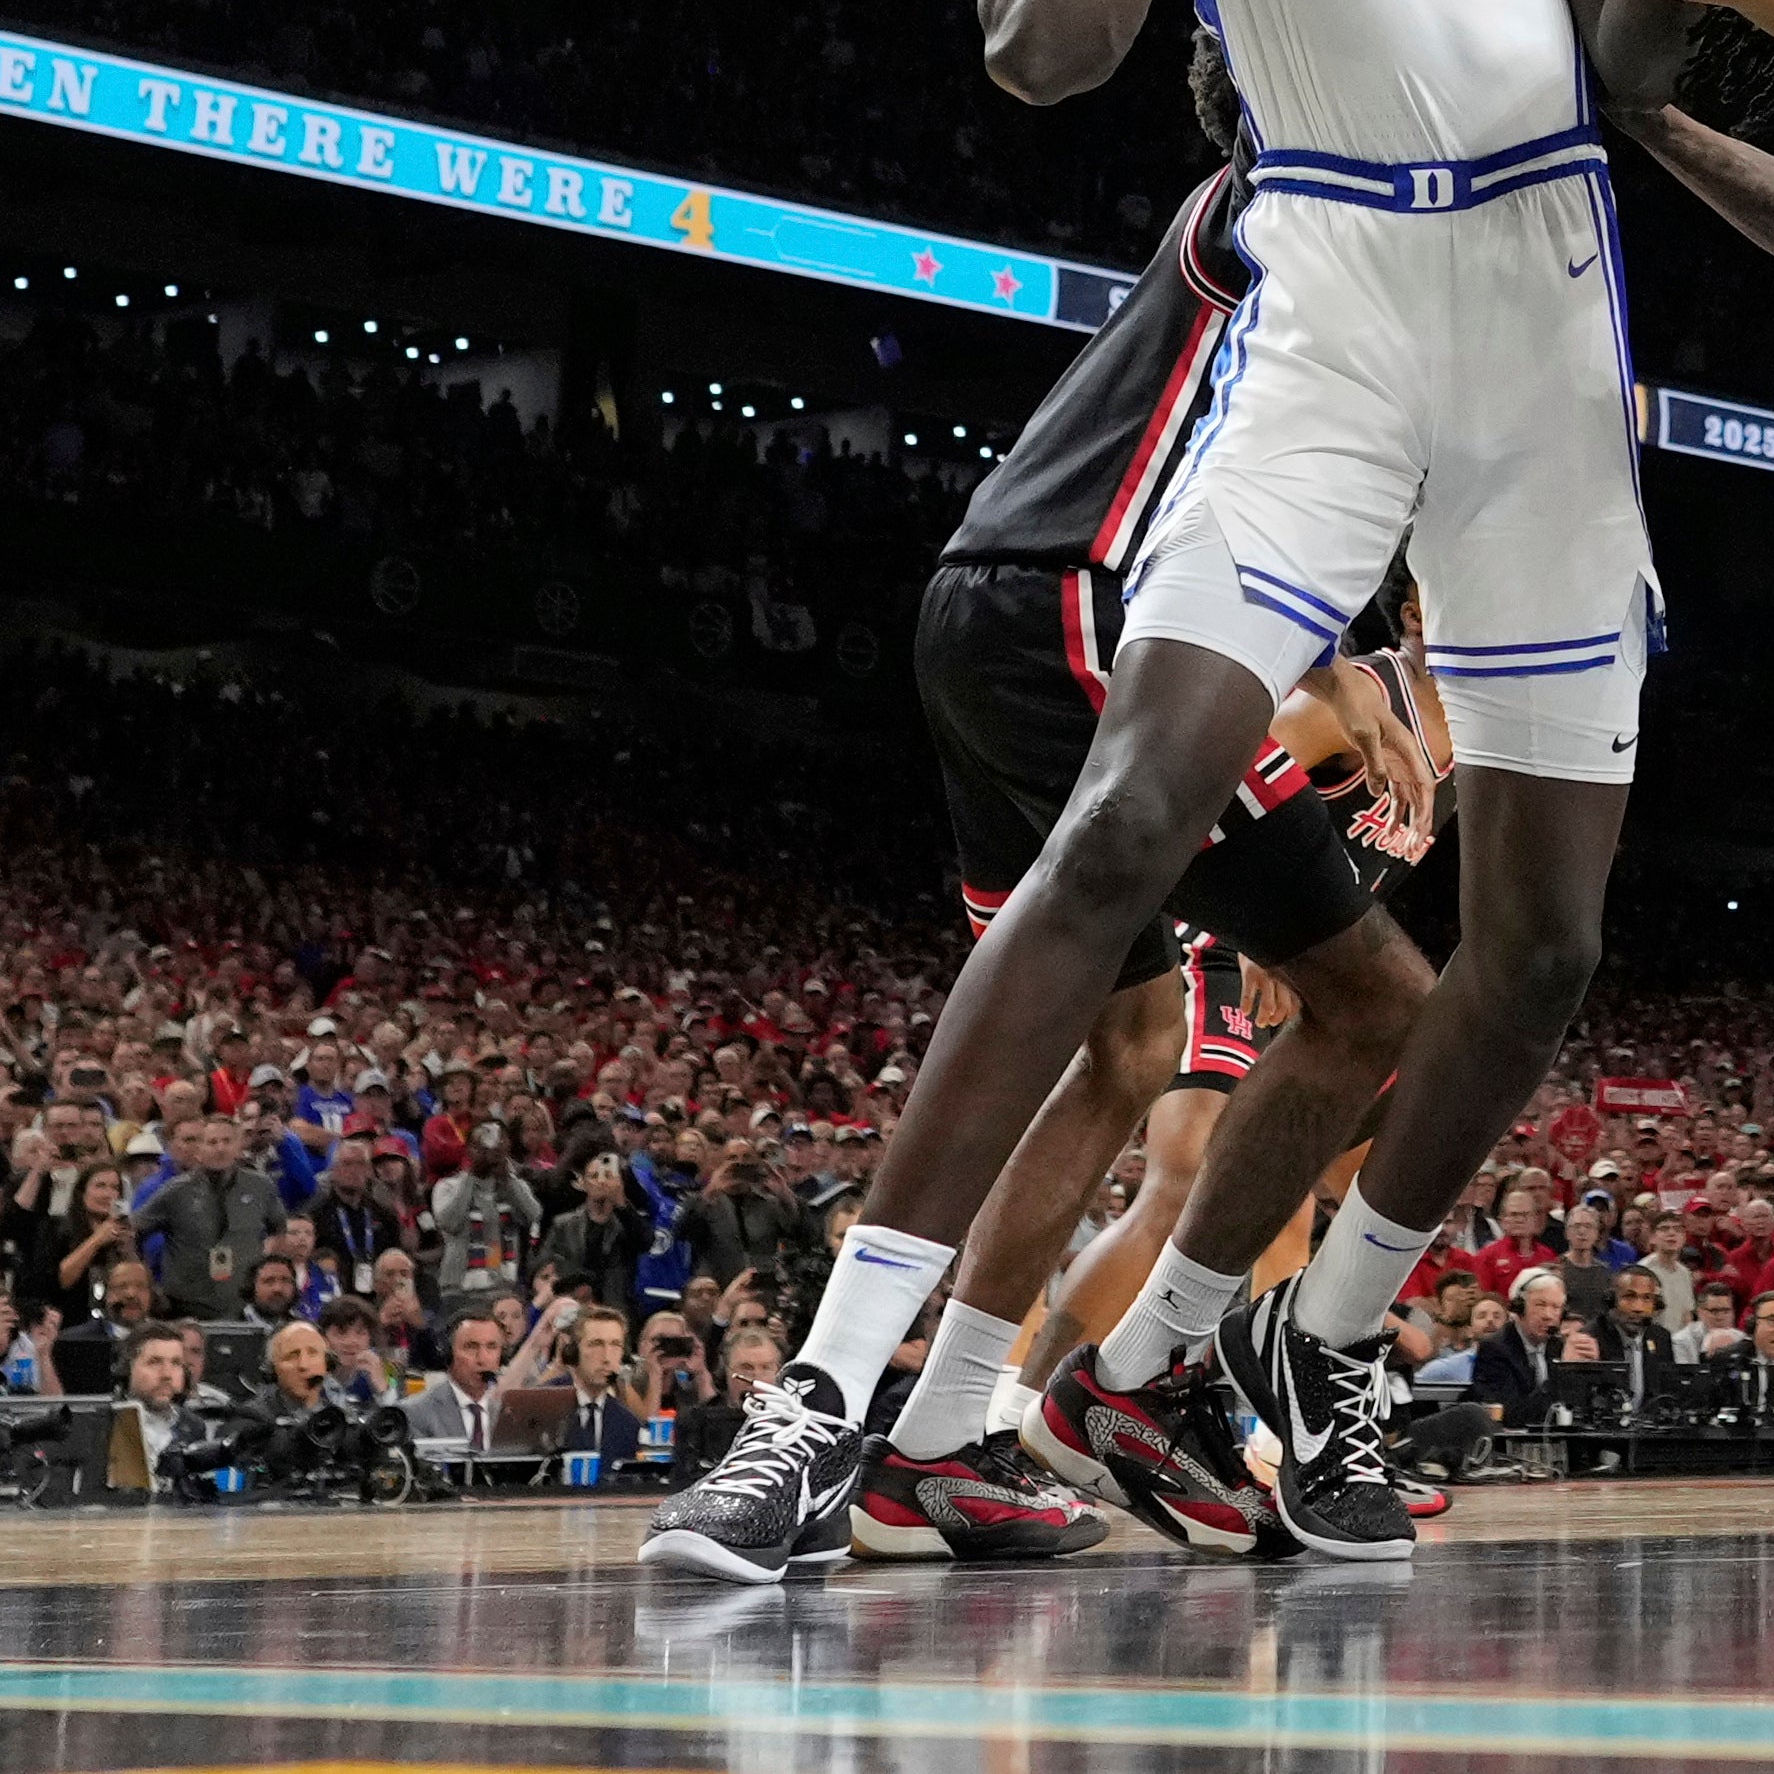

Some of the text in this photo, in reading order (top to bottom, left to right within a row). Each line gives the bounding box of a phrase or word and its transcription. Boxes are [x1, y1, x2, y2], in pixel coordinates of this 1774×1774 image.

[138, 78, 396, 179] THERE
[434, 142, 635, 228] WERE
[670, 189, 714, 251] 4
[1409, 168, 1455, 208] D
[1220, 1005, 1254, 1041] UH
